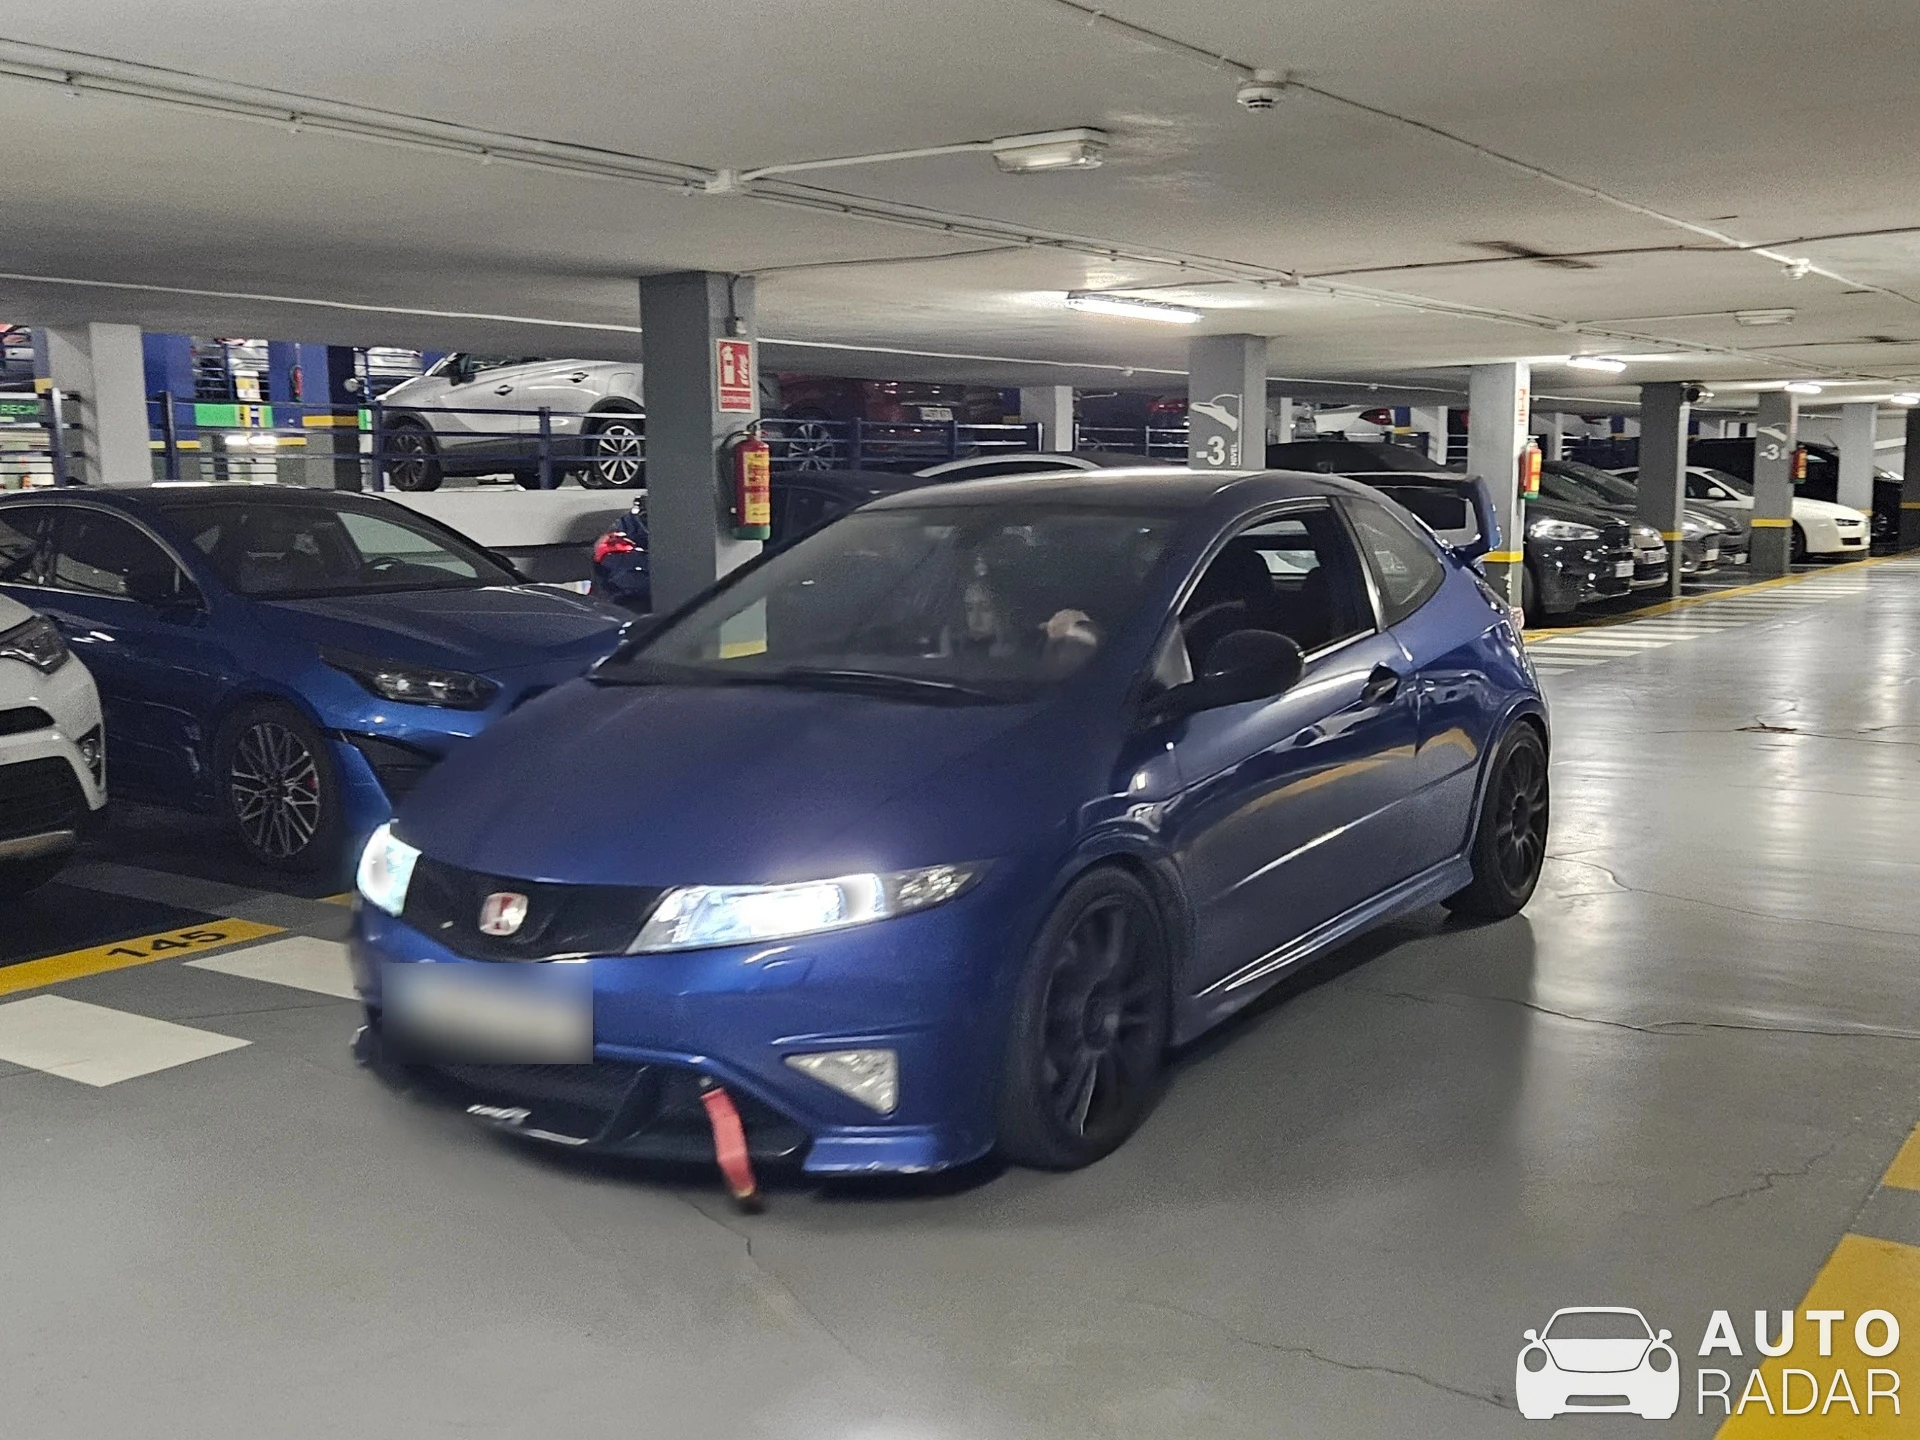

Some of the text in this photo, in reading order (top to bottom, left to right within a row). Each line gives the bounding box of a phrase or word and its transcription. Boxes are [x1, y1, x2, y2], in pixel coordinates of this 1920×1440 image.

[1196, 435, 1226, 466] -3
[1759, 443, 1780, 460] -3
[106, 930, 227, 957] 145
